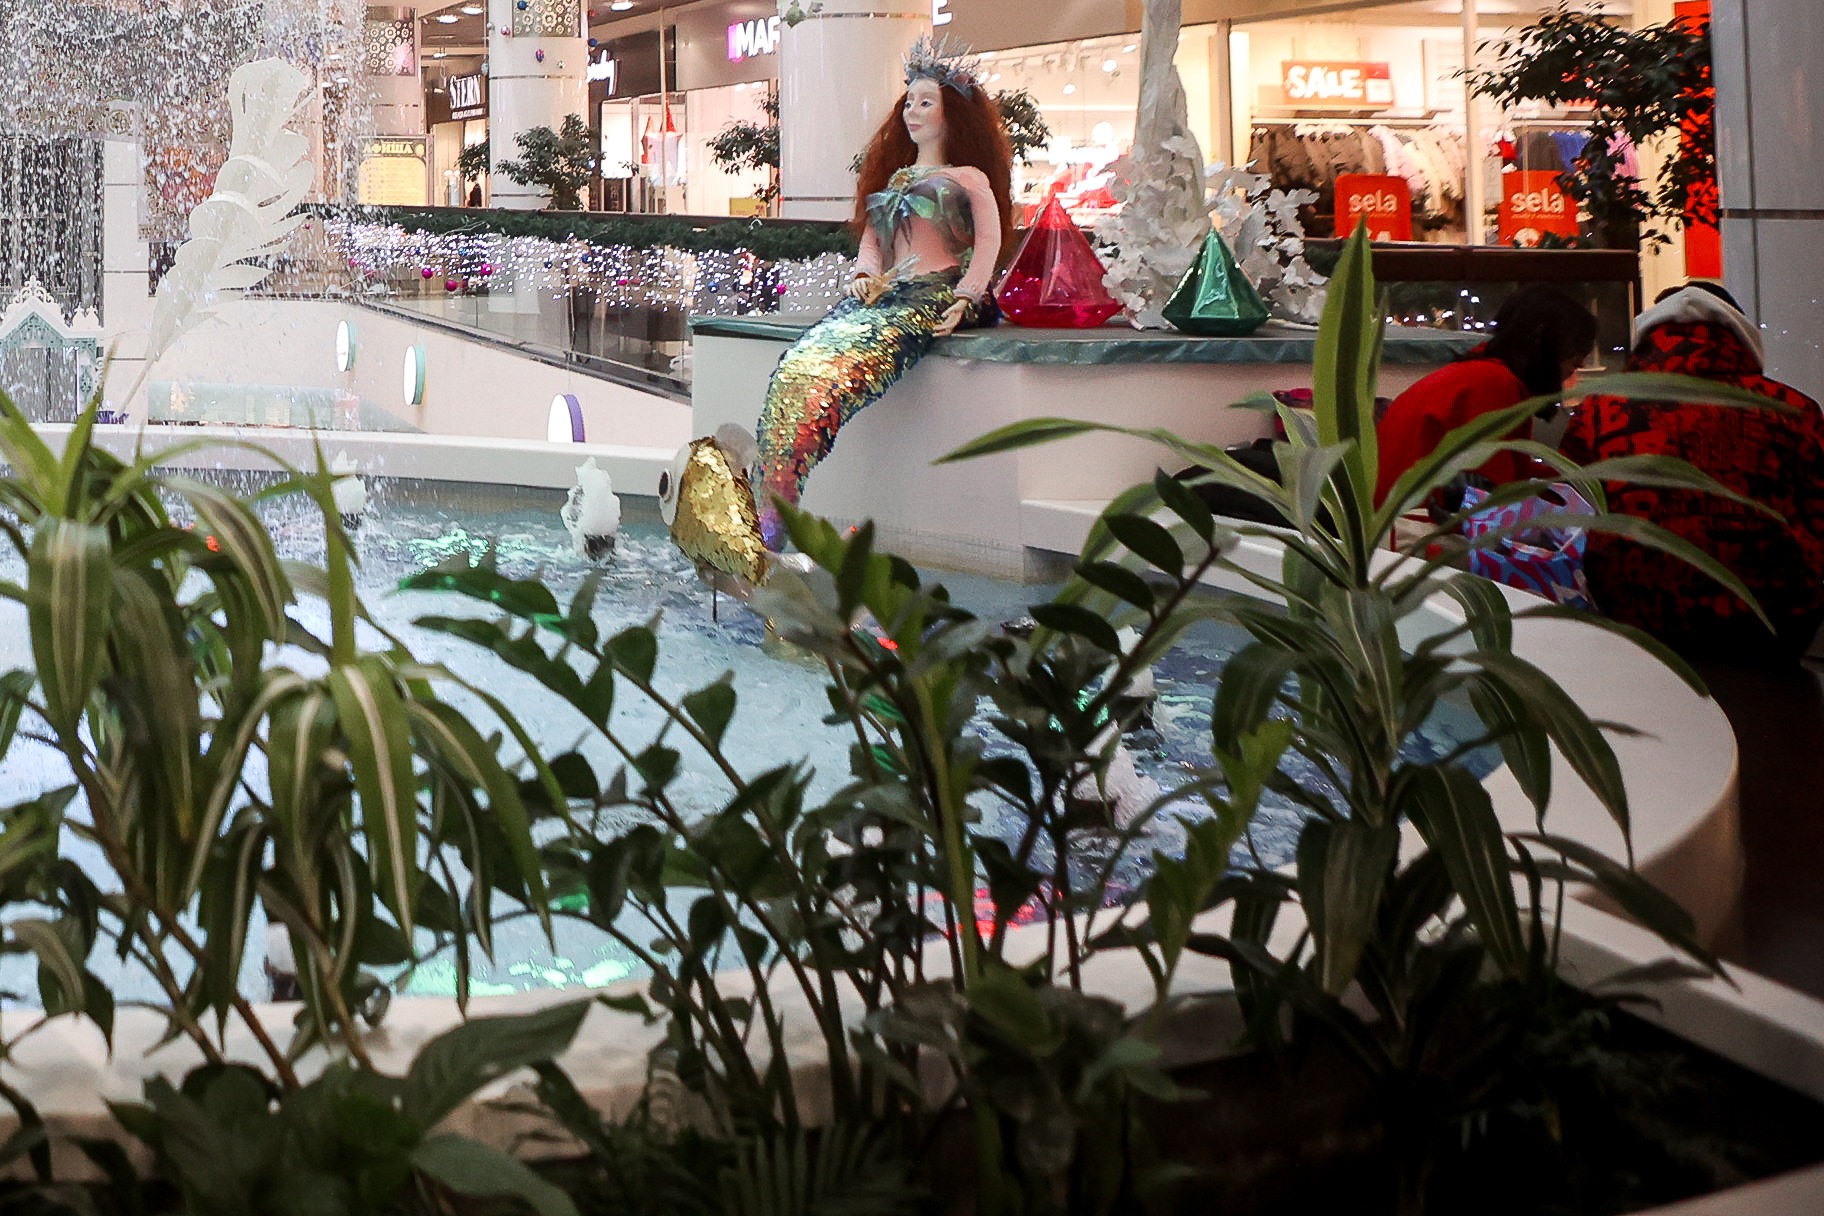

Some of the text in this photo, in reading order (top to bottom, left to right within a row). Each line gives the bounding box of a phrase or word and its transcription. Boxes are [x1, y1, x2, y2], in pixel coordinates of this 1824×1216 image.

[449, 74, 481, 109] STERN
[1288, 65, 1364, 99] SALE
[363, 142, 414, 154] АФИША
[1348, 188, 1398, 213] sela
[1510, 187, 1565, 214] sela
